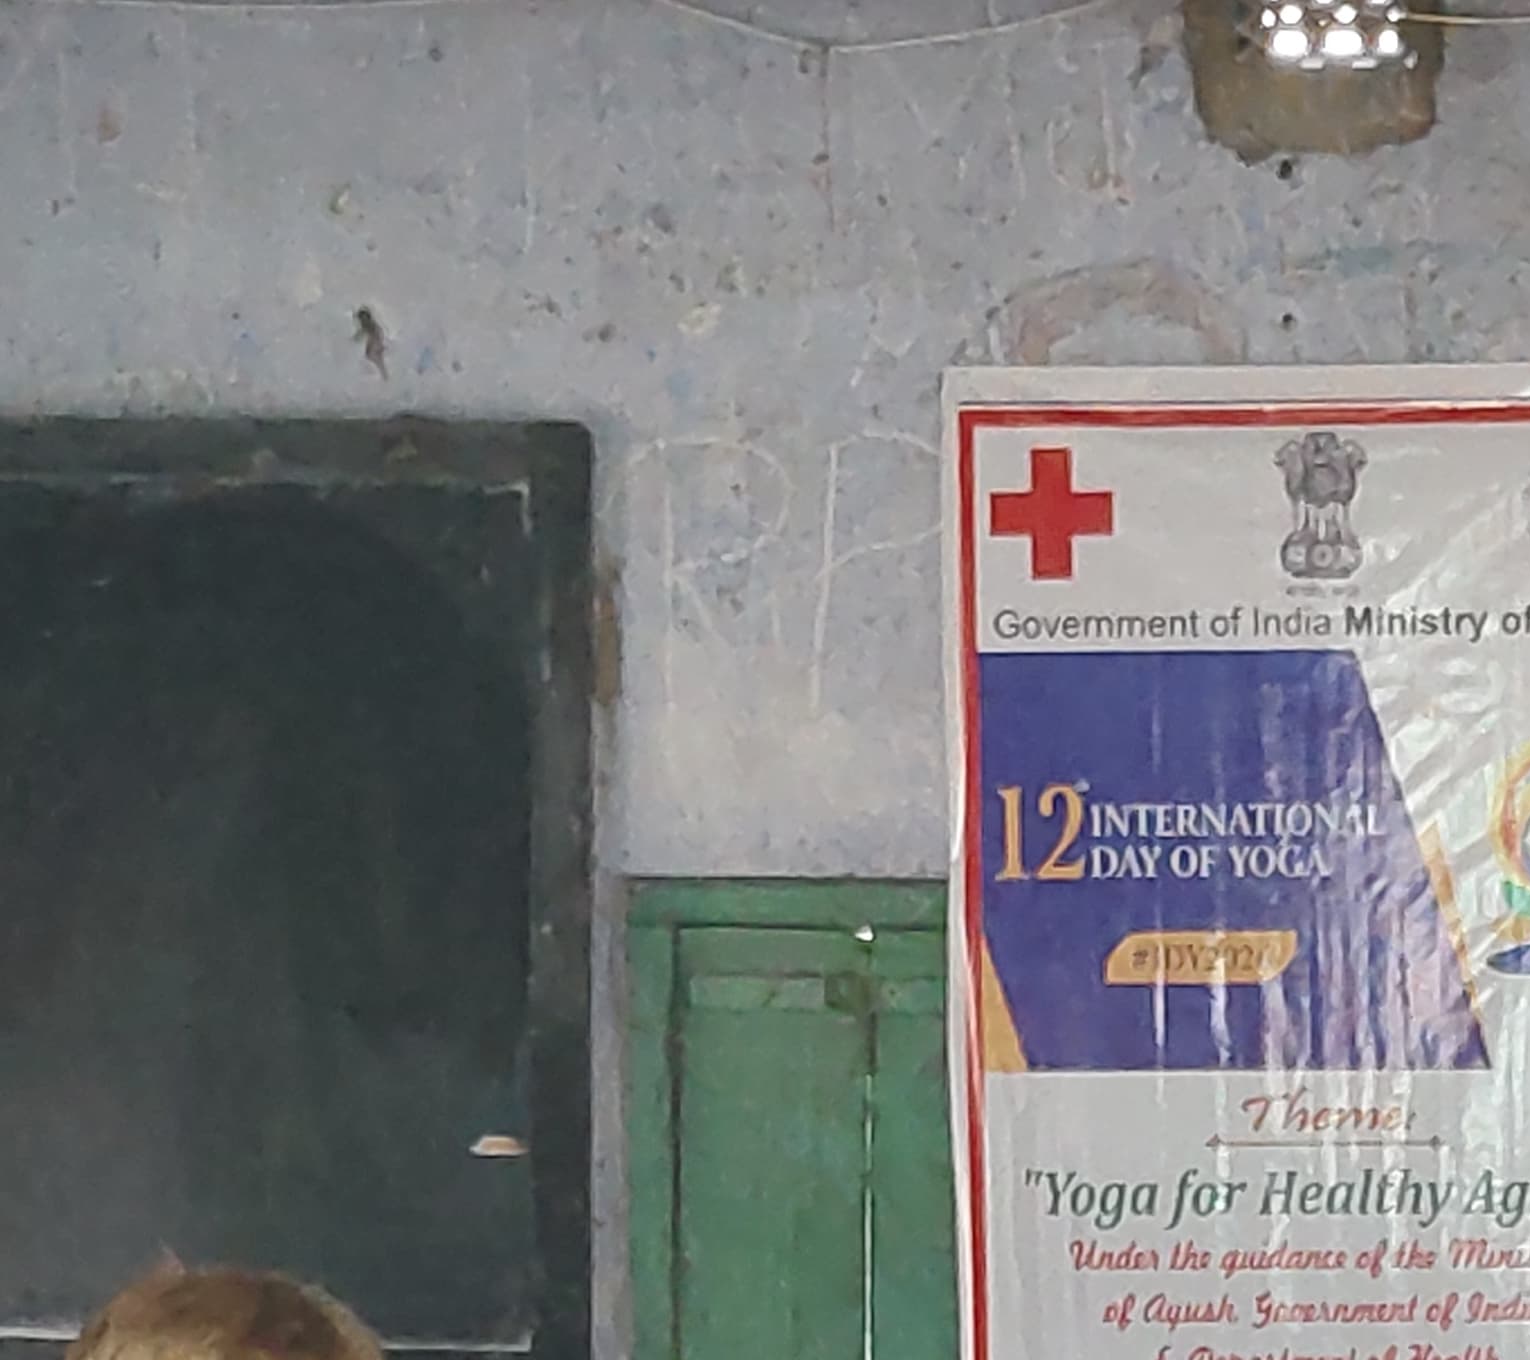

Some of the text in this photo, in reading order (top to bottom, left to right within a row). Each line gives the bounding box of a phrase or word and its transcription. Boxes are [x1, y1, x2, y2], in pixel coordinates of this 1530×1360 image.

[993, 608, 1200, 640] Government
[1209, 605, 1243, 638] of
[1253, 606, 1331, 636] India
[1345, 604, 1485, 643] Ministry
[1090, 802, 1387, 838] INTERNATIONAL
[1091, 845, 1333, 880] DAY OF YOGA
[1163, 1168, 1247, 1231] for
[1259, 1167, 1452, 1229] Healthy
[1070, 1239, 1159, 1271] Under
[1168, 1239, 1210, 1271] the
[1219, 1239, 1347, 1279] guidance
[1356, 1238, 1388, 1278] of
[1393, 1239, 1437, 1270] the
[1102, 1292, 1137, 1331] of
[1252, 1290, 1418, 1330] Government
[1425, 1292, 1460, 1332] of
